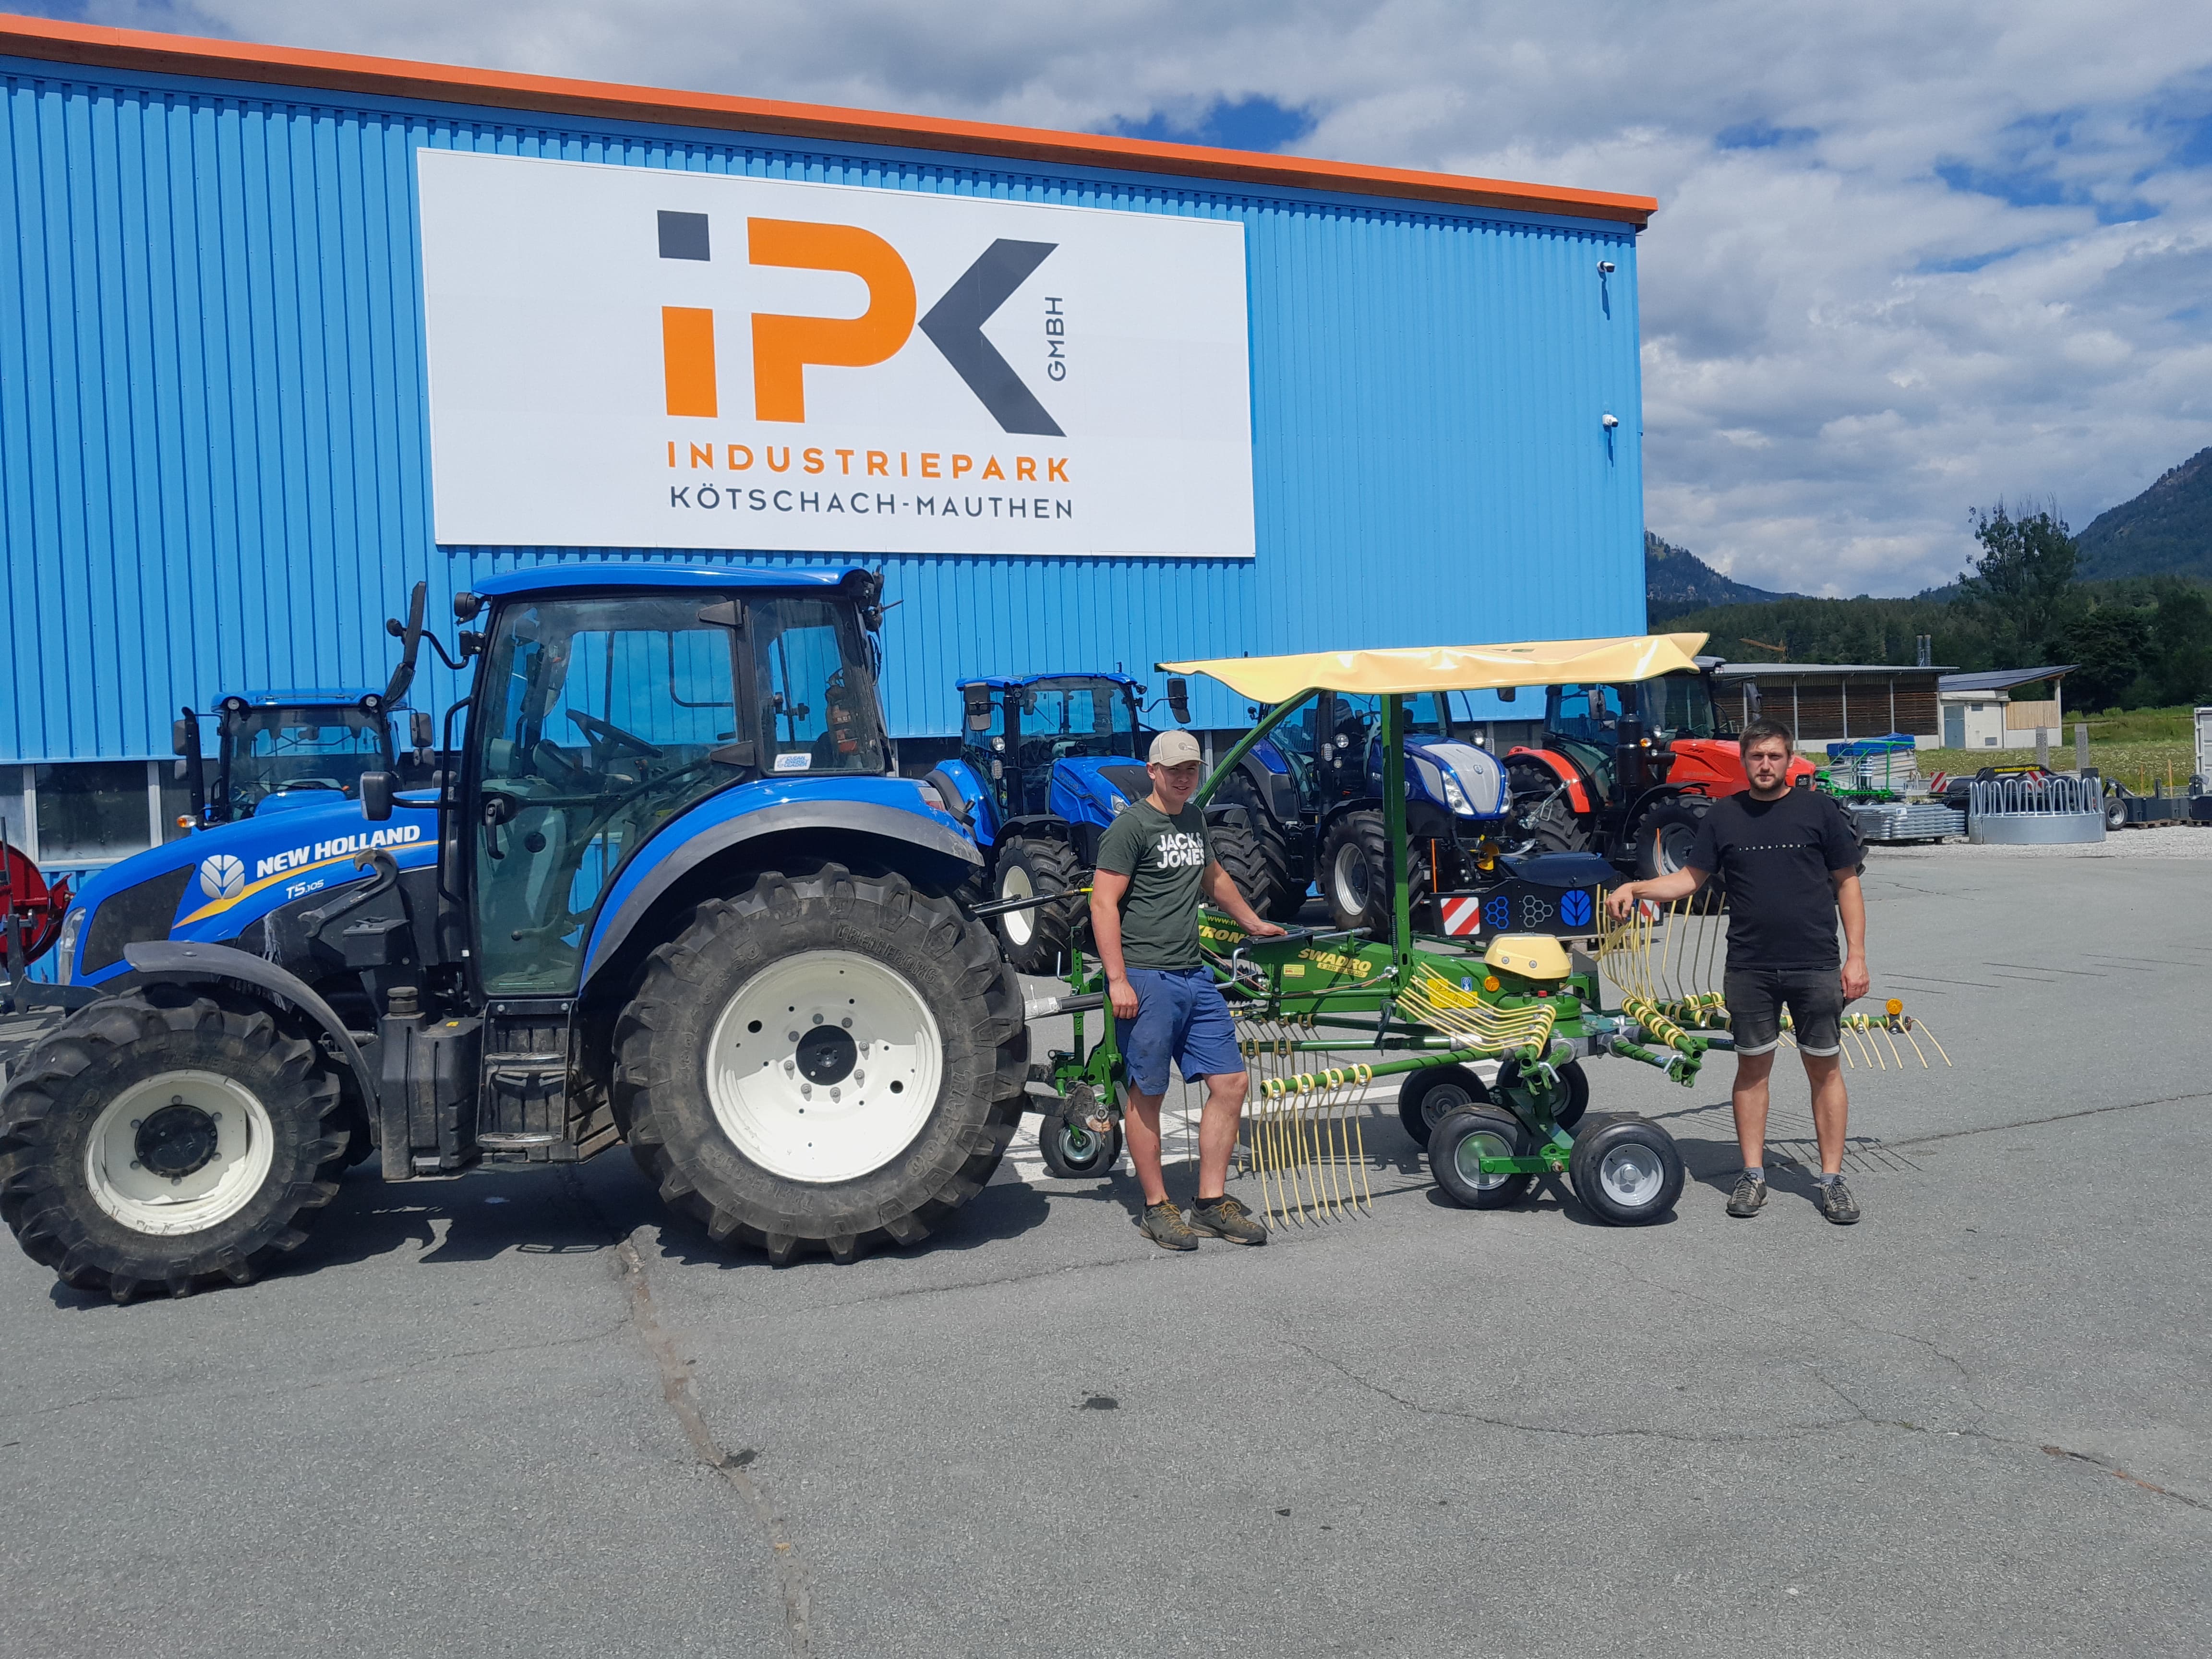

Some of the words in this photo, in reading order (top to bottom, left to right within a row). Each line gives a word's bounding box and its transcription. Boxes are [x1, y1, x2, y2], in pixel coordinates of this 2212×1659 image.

[1044, 297, 1067, 382] GMBH
[667, 441, 1070, 482] INDUSTRIEPARK
[670, 482, 1073, 519] KÖTSCHACH-MAUTHEN
[256, 845, 311, 878] NEW
[314, 825, 421, 861] HOLLAND
[1157, 848, 1204, 868] JONES
[286, 878, 325, 900] T5.105
[1198, 925, 1250, 944] RON
[838, 923, 937, 984] TRELLEBORG
[1298, 948, 1372, 972] SWADRO
